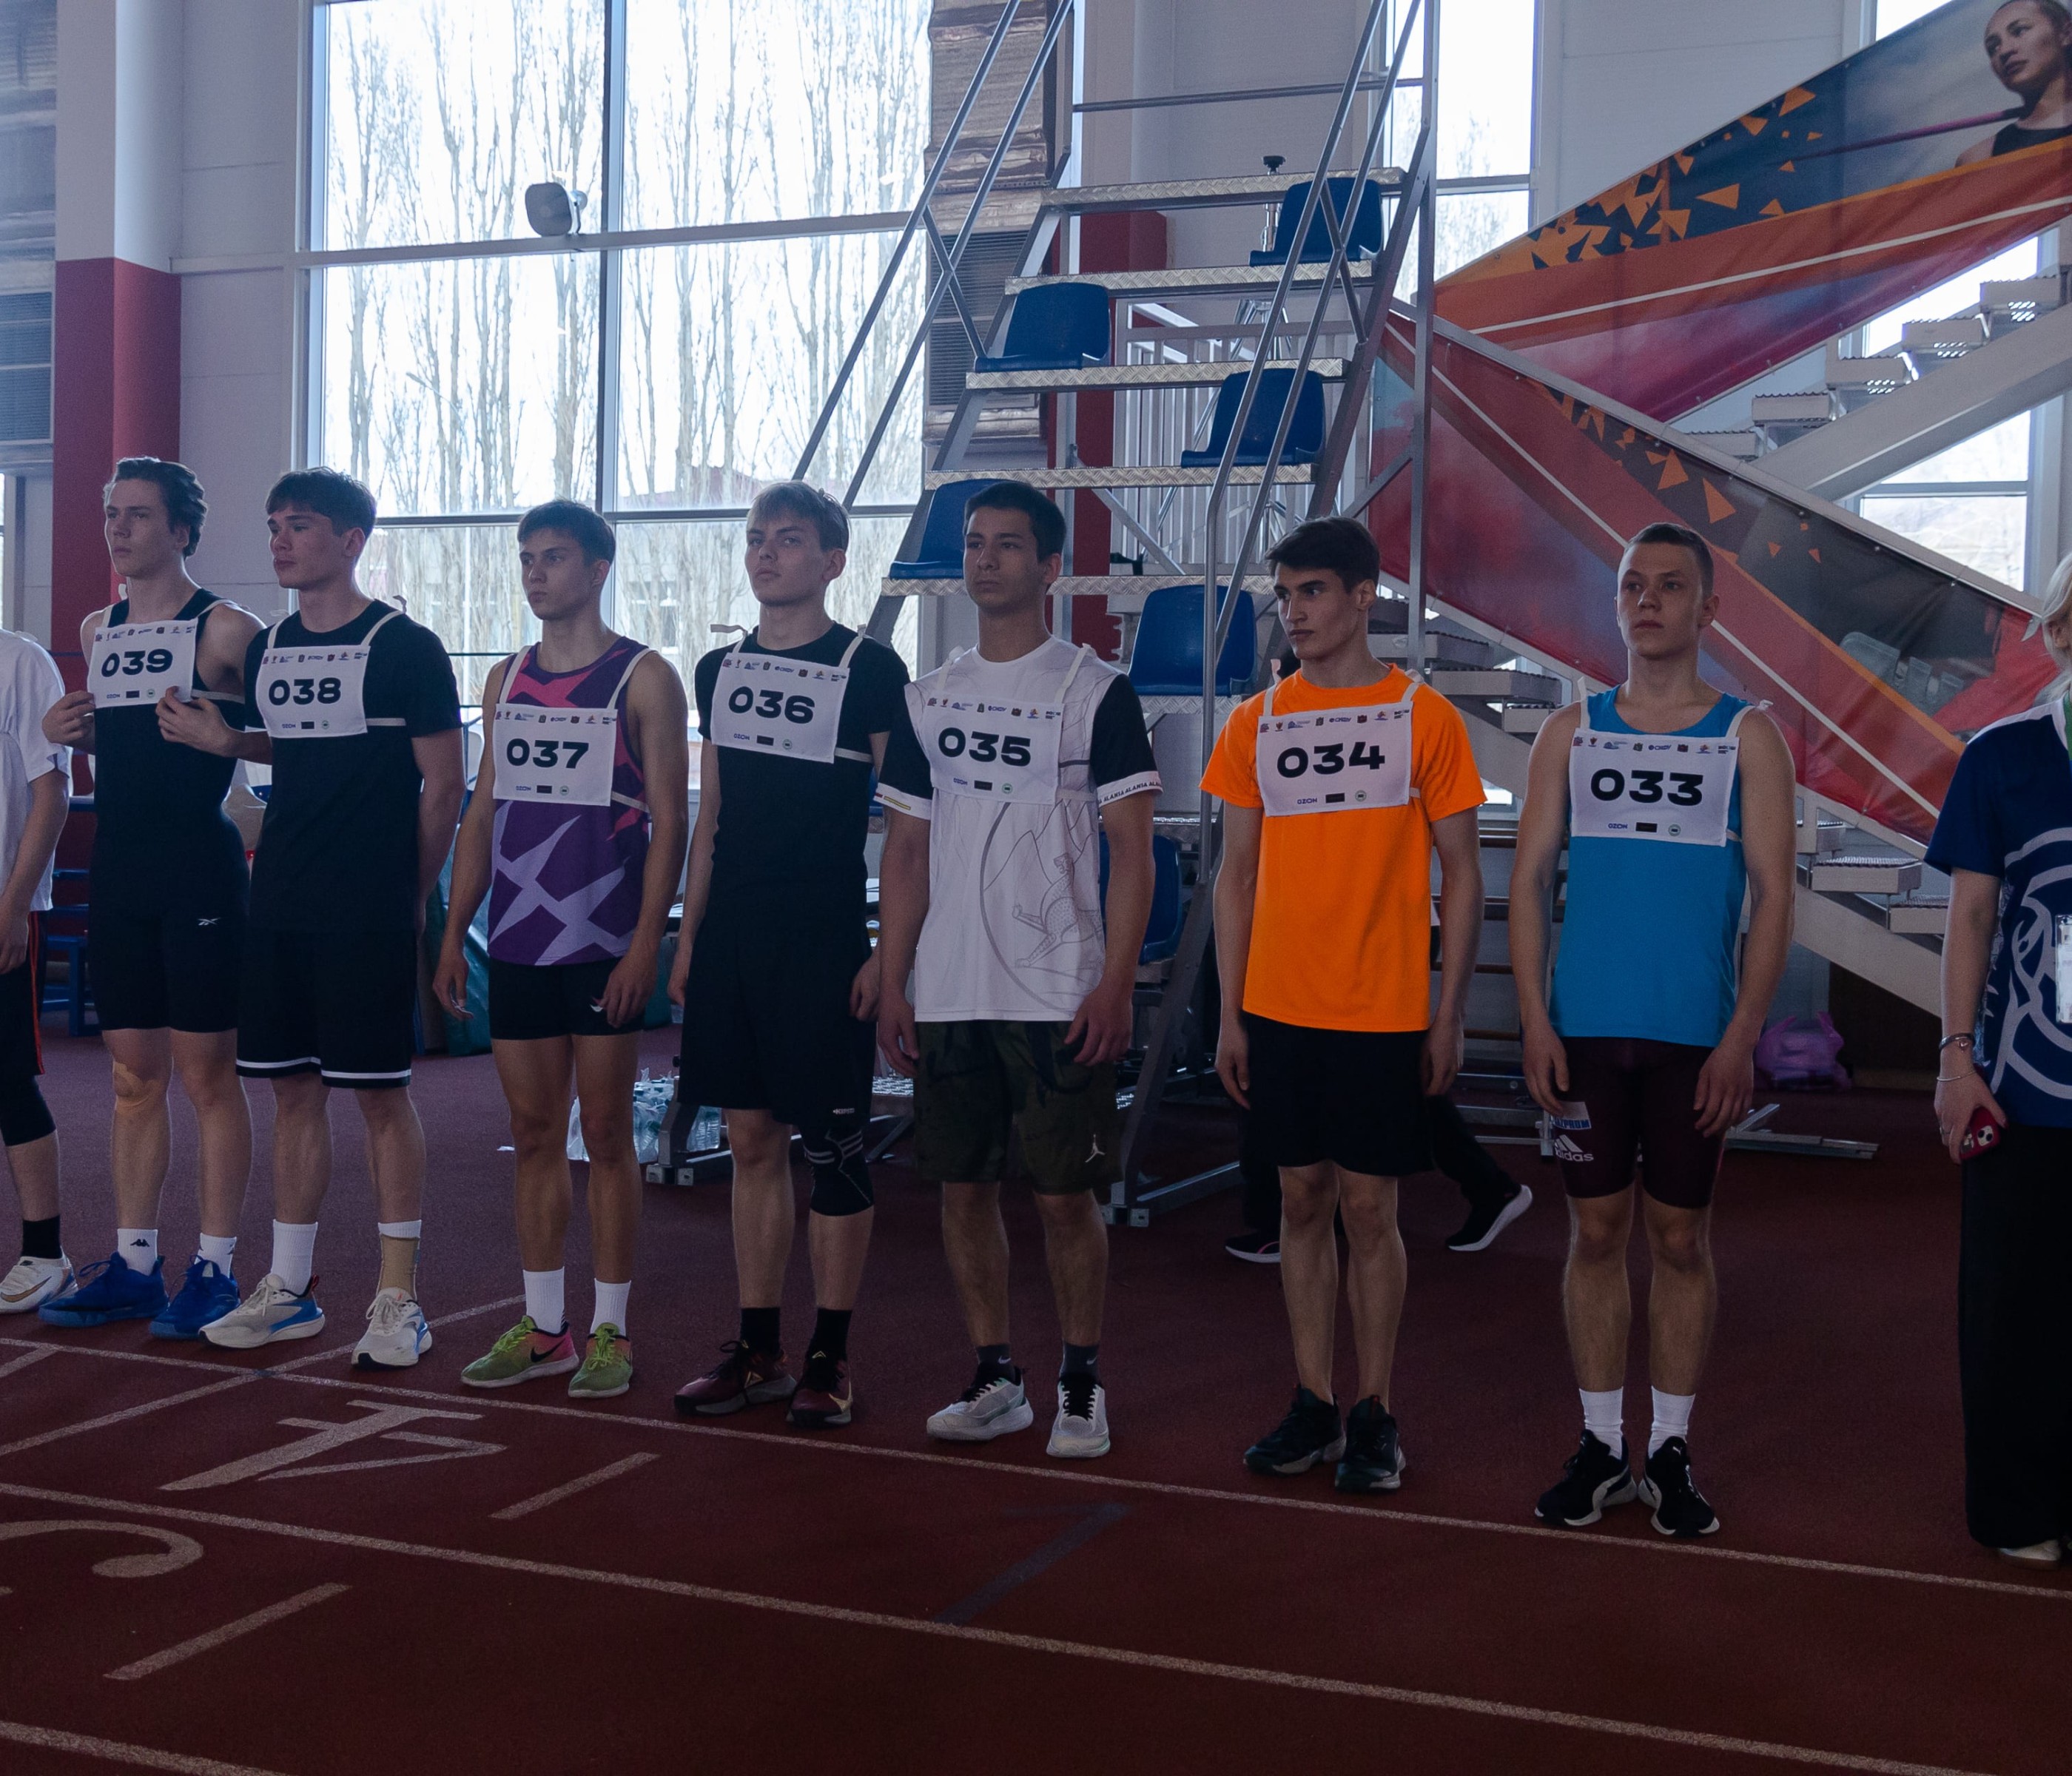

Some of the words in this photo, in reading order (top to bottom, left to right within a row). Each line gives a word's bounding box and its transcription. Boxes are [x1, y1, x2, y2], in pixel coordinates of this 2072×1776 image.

[101, 648, 173, 677] 039
[269, 677, 341, 706] 038
[728, 686, 815, 724] 036
[506, 738, 589, 769] 037
[938, 727, 1031, 767] 035
[1277, 741, 1385, 778] 034
[1591, 768, 1703, 807] 033
